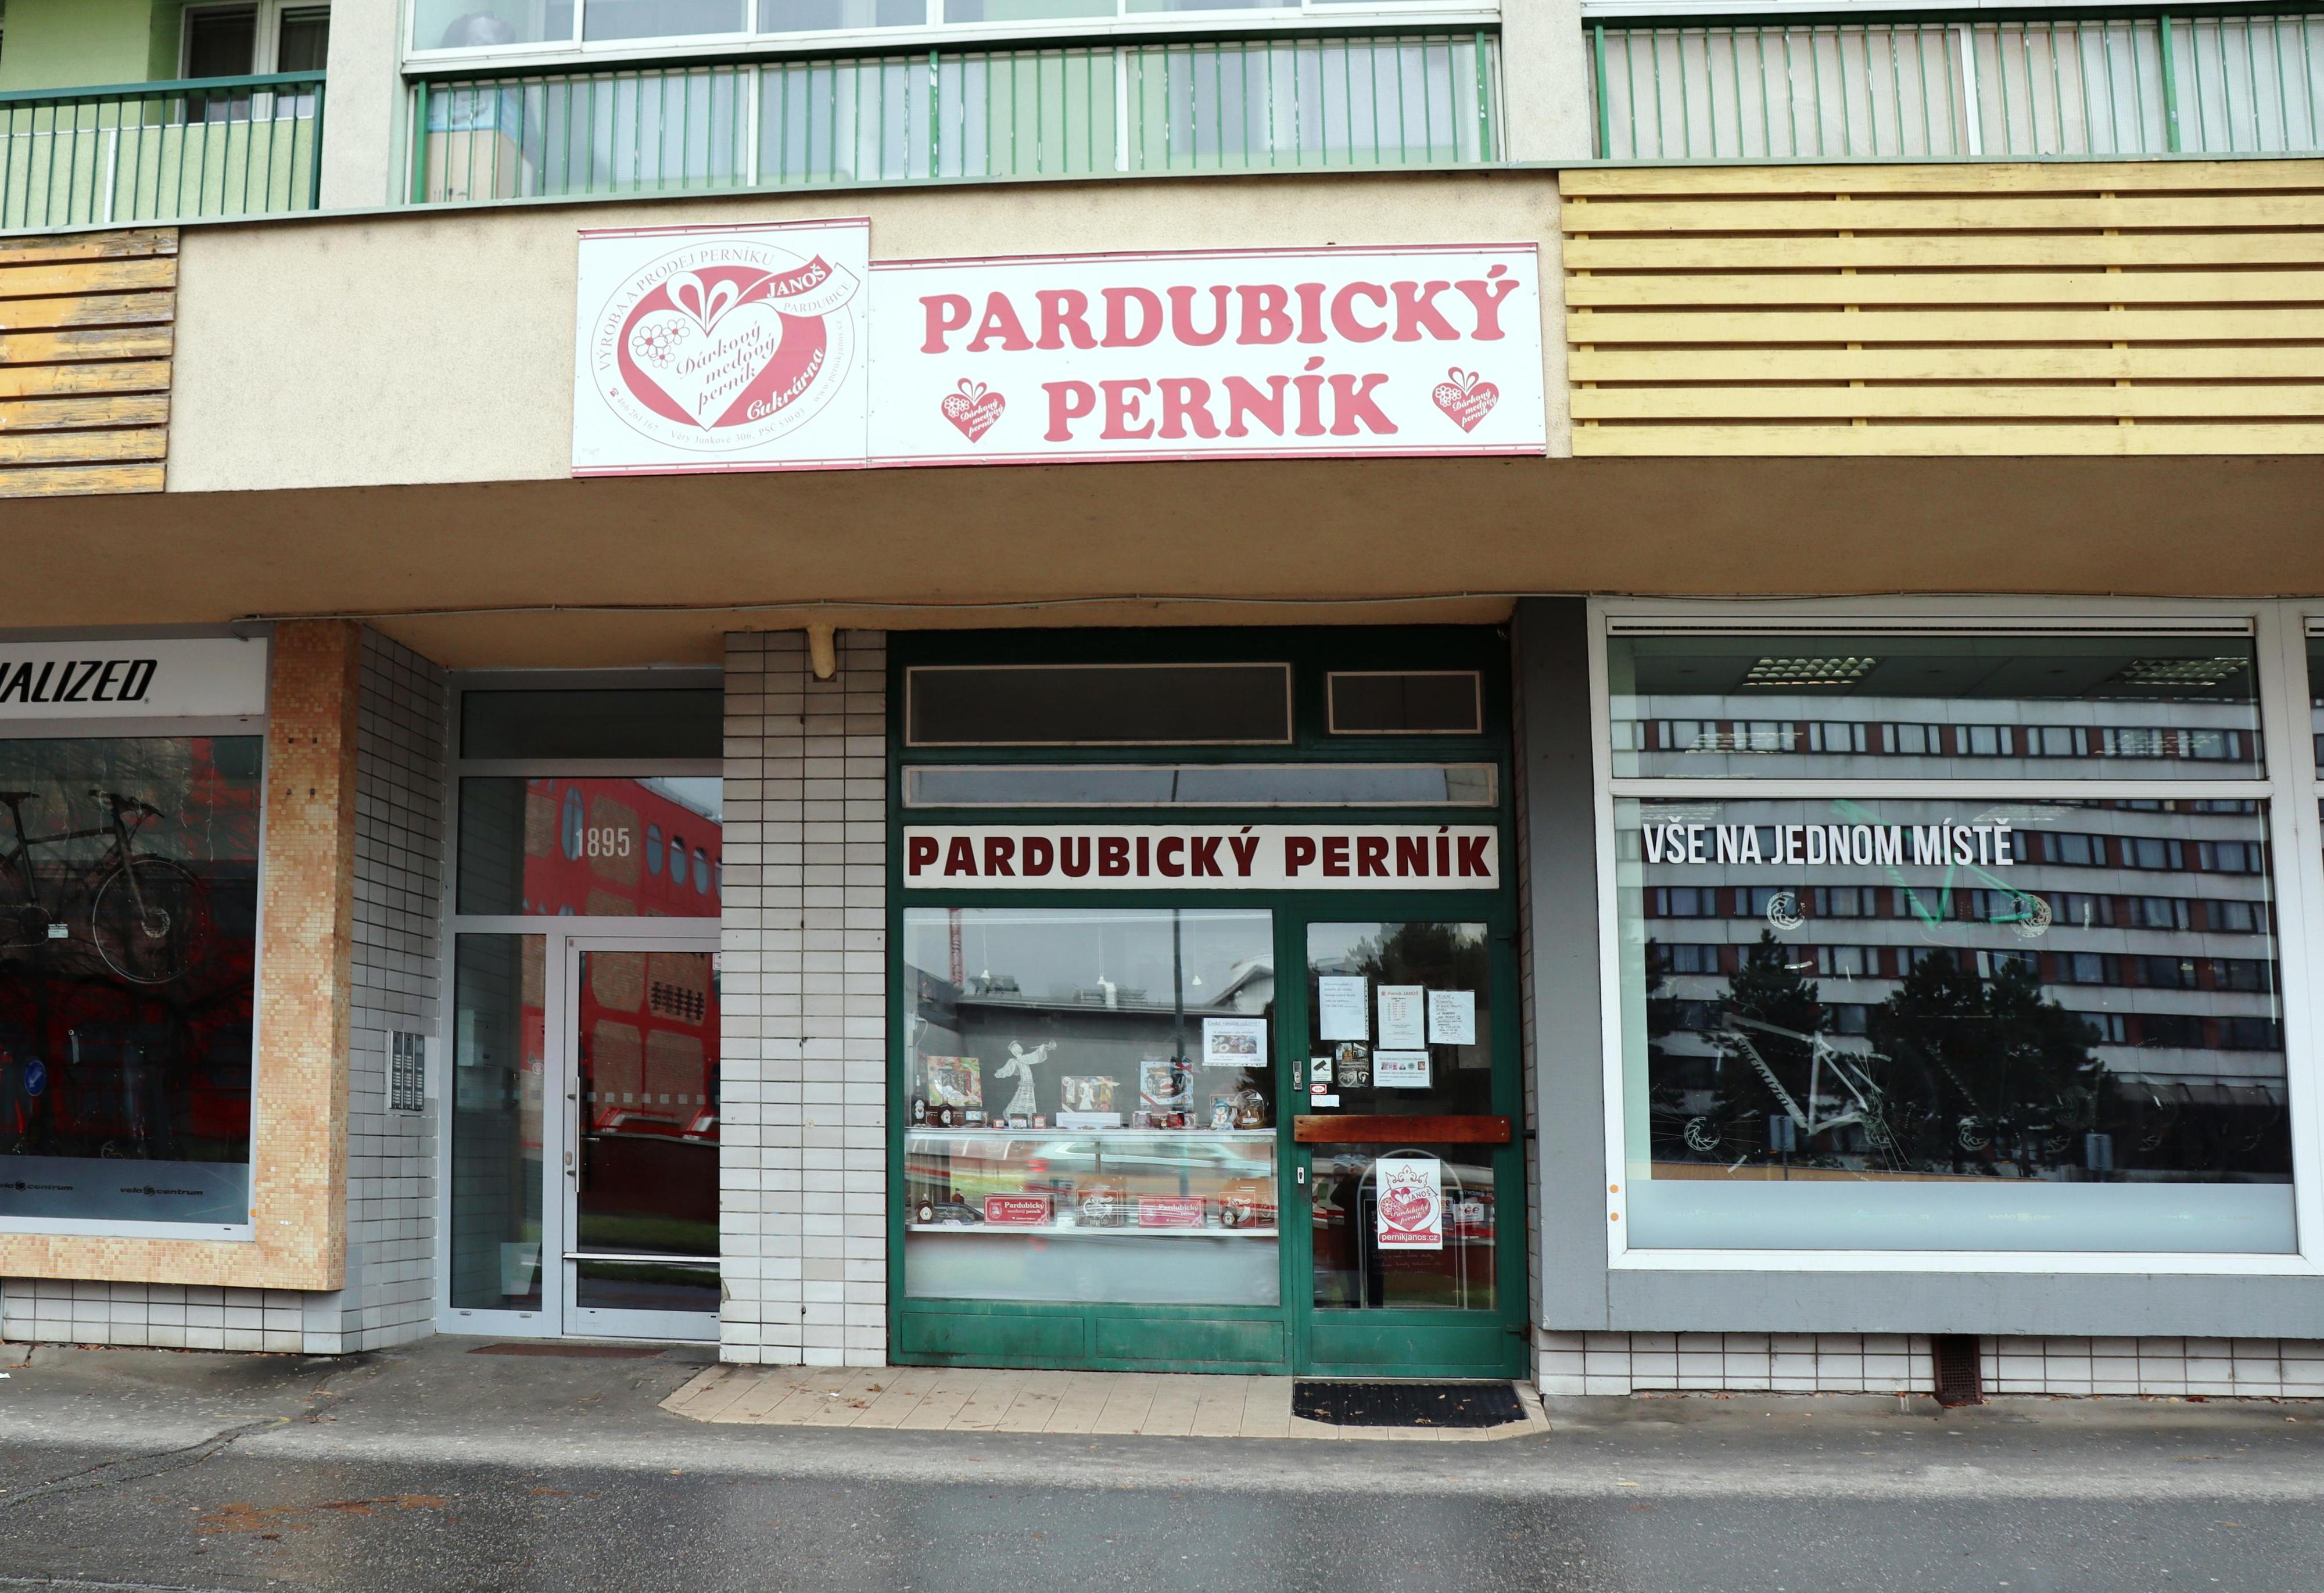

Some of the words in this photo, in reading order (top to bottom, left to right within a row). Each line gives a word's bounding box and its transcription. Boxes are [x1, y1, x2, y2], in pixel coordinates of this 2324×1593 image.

[766, 263, 826, 298] JANOŠ
[784, 281, 851, 312] PARDUBICE
[596, 304, 628, 371] VÝROBA
[627, 291, 638, 303] A
[636, 253, 694, 291] PRODEJ
[700, 246, 775, 266] PERNÍKU
[919, 264, 1520, 354] PARDUBICKÝ
[676, 320, 761, 379] Dárkový
[706, 332, 774, 384] medový
[698, 362, 755, 415] perník
[747, 346, 823, 419] Cukrárna
[1043, 356, 1398, 442] PERNÍK
[576, 827, 630, 857] 1895
[909, 826, 1261, 877] PARDUBICKÝ
[1285, 826, 1491, 877] PERNÍK
[1642, 816, 1706, 864] VŠE
[1716, 824, 1762, 864] NA
[1770, 824, 1903, 866] JEDNOM
[1913, 817, 2014, 866] MÍSTĚ
[1737, 1038, 1789, 1107] SPECIALIZED
[1407, 1189, 1431, 1201] JANOŠ
[1382, 1234, 1438, 1242] pernikjanos.cz
